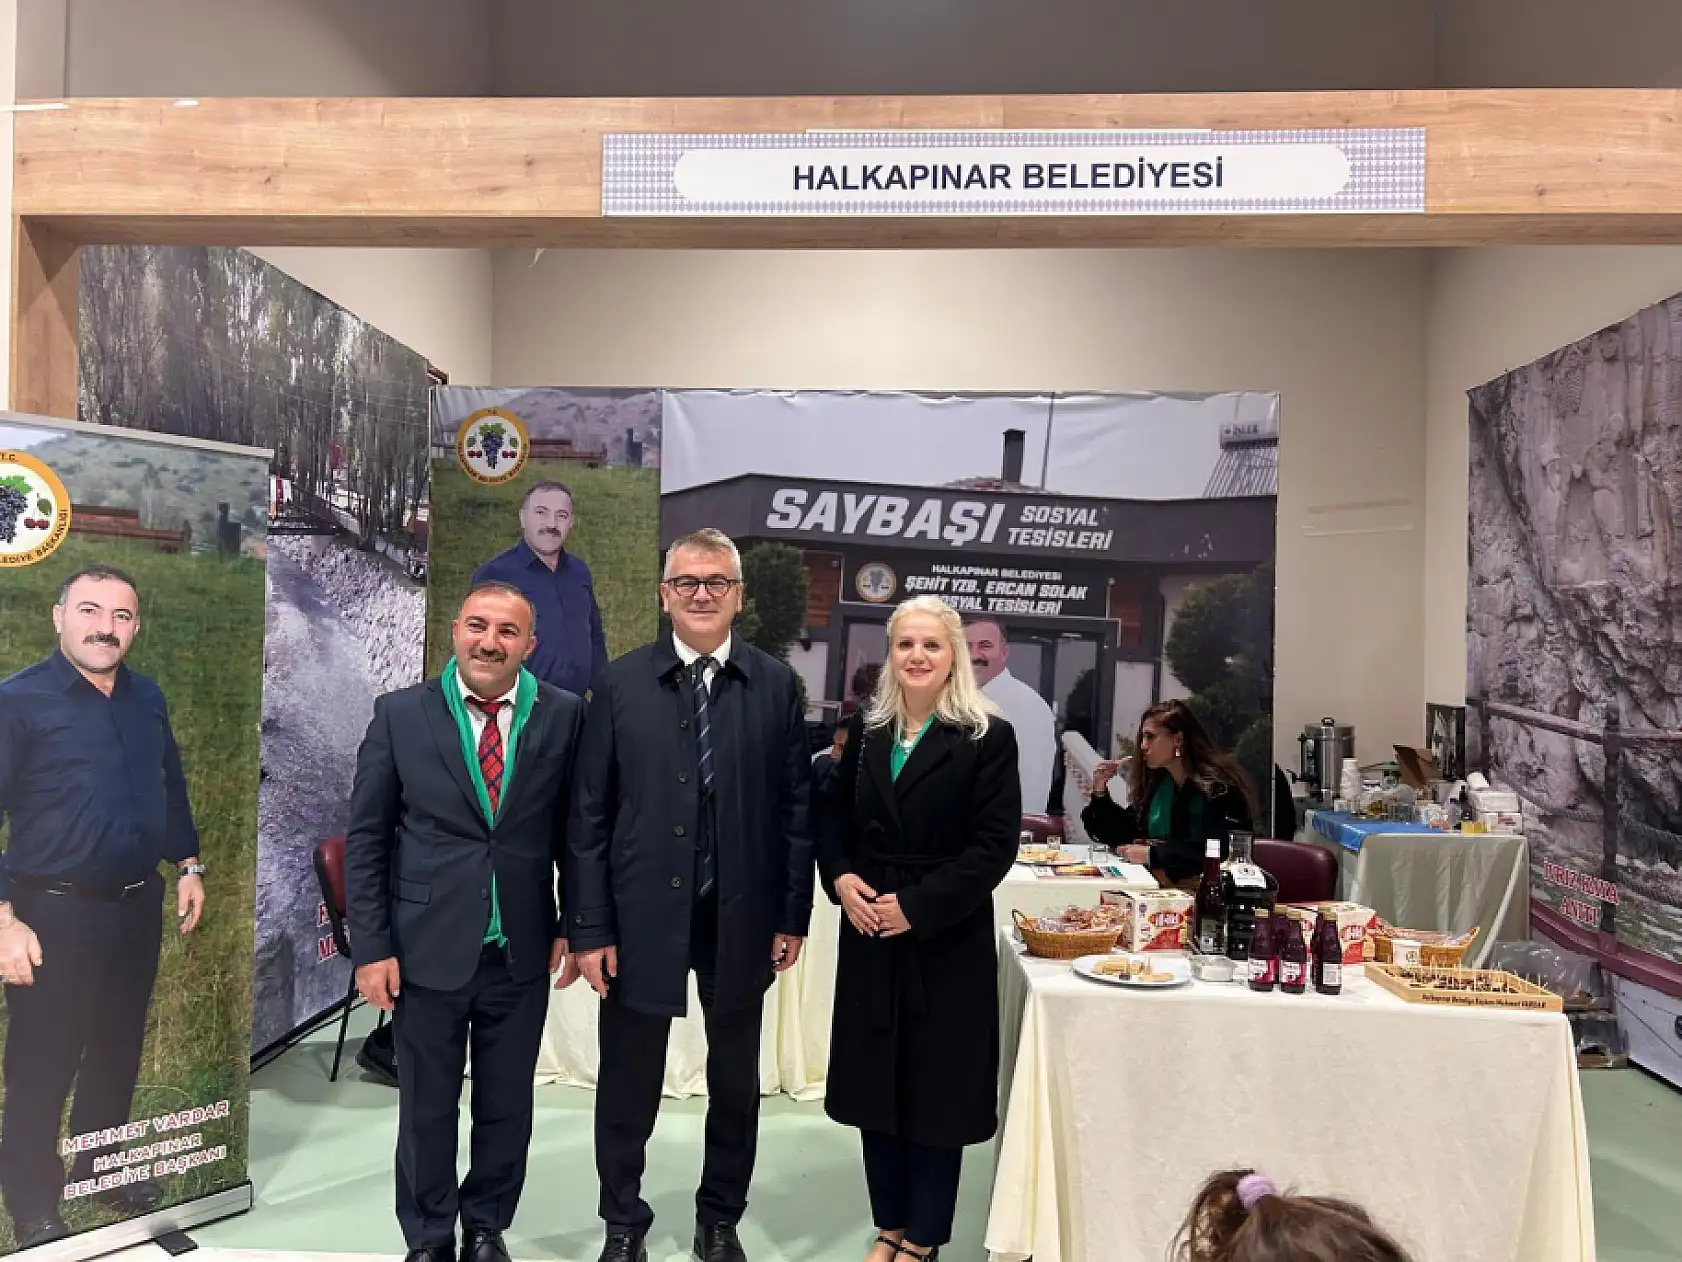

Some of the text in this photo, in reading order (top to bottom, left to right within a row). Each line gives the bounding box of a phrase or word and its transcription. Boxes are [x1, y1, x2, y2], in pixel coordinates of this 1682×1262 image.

[793, 156, 1223, 190] HALKAPINAR BELEDİYESİ
[766, 488, 1006, 547] SAYBAŞI
[1020, 505, 1099, 527] SOSYAL
[1007, 526, 1114, 551] TESİSLERİ
[932, 564, 998, 577] HALKAPINAR
[905, 575, 949, 592] ŞEHİT
[985, 581, 1036, 597] ERCAN
[1038, 584, 1088, 600] SOLAK
[987, 597, 1063, 616] TESİSLERİ
[62, 1100, 230, 1154] MEHMET VARDAR
[93, 1133, 203, 1173] HALKAPINAR
[64, 1144, 228, 1200] BELEDİYE BAŞKANI
